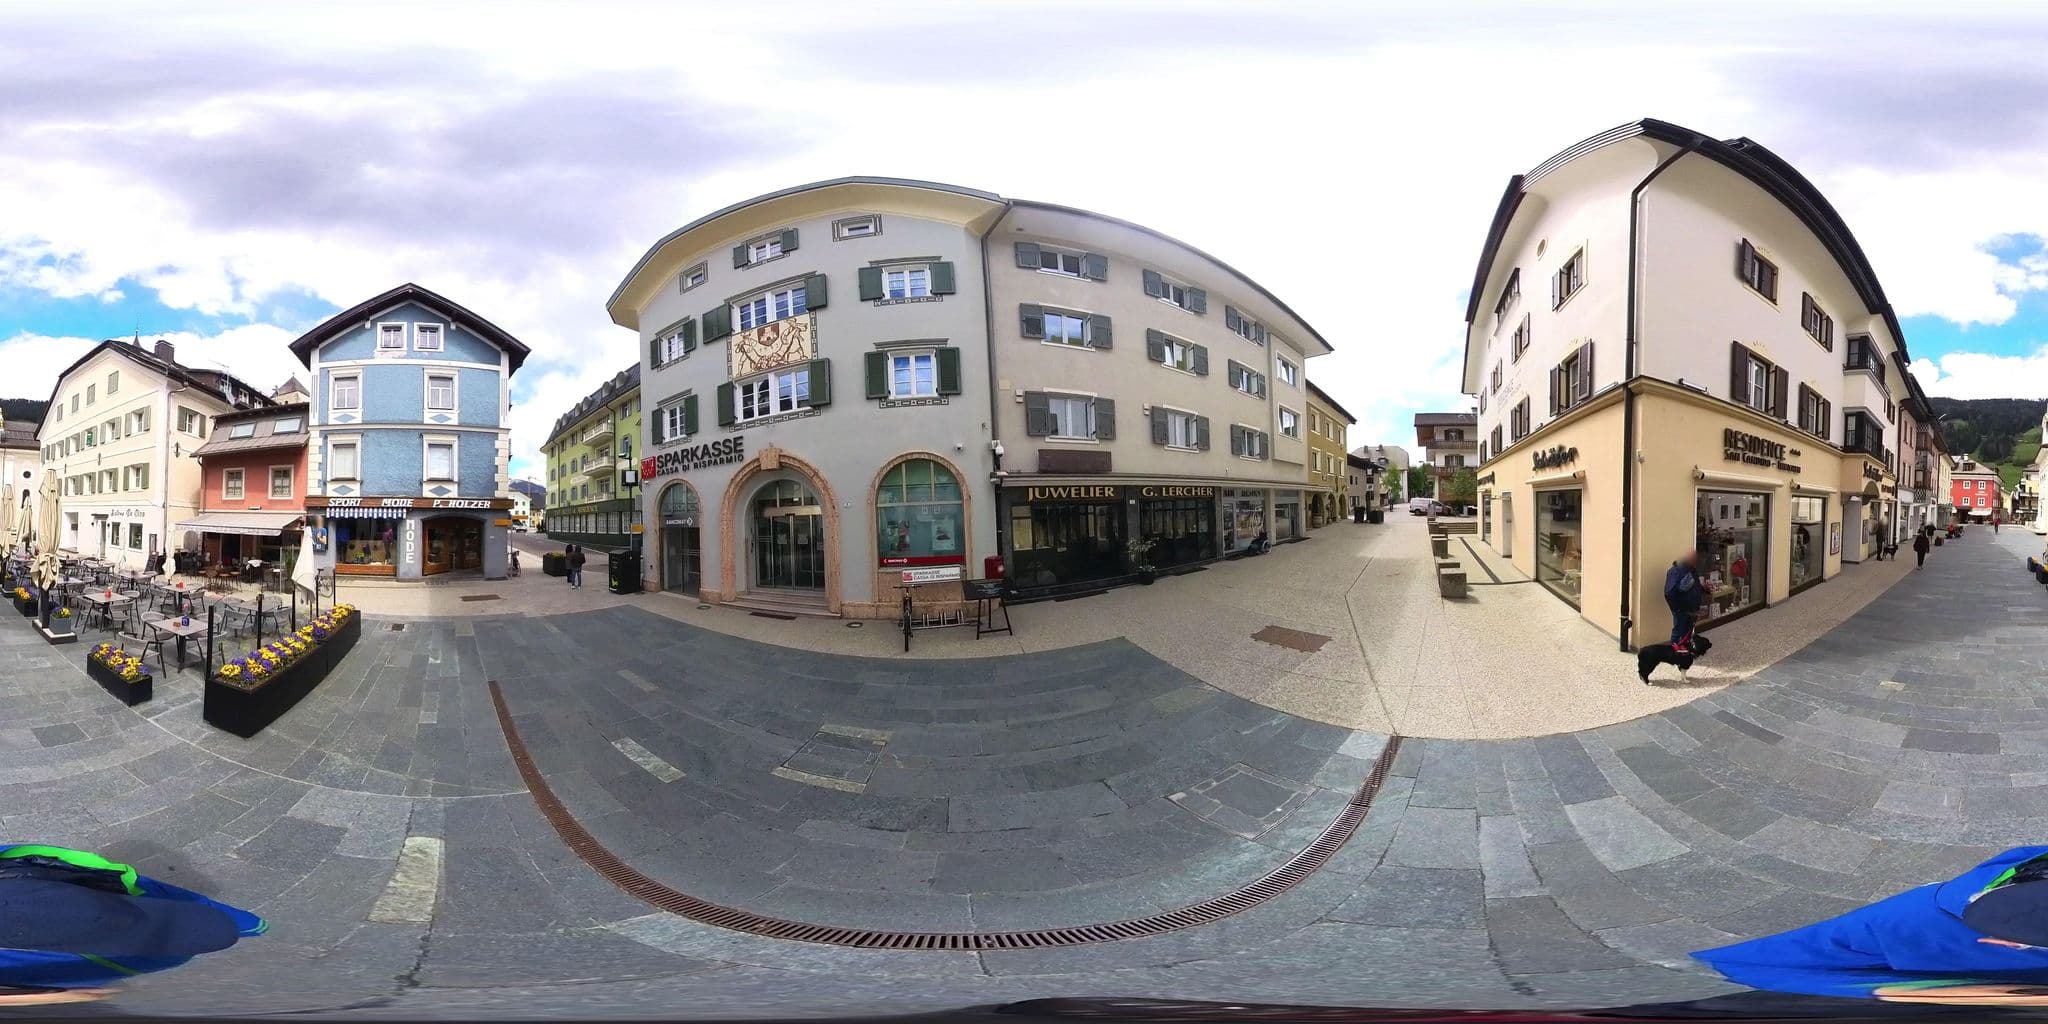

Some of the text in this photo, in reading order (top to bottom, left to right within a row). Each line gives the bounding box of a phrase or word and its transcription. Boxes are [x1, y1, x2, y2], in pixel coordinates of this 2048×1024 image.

[657, 435, 744, 469] SPARKASSE
[1724, 428, 1786, 461] RESIDENCE
[657, 466, 679, 477] CASSA
[682, 464, 690, 472] DI
[694, 453, 745, 469] RISPARMIO
[328, 498, 363, 507] SPORT
[381, 498, 415, 508] MODE
[448, 500, 491, 509] HOLZER
[1027, 486, 1115, 502] JUWELIER
[1142, 486, 1158, 497] G.
[1162, 486, 1213, 497] LERCHER
[406, 519, 415, 564] MODE
